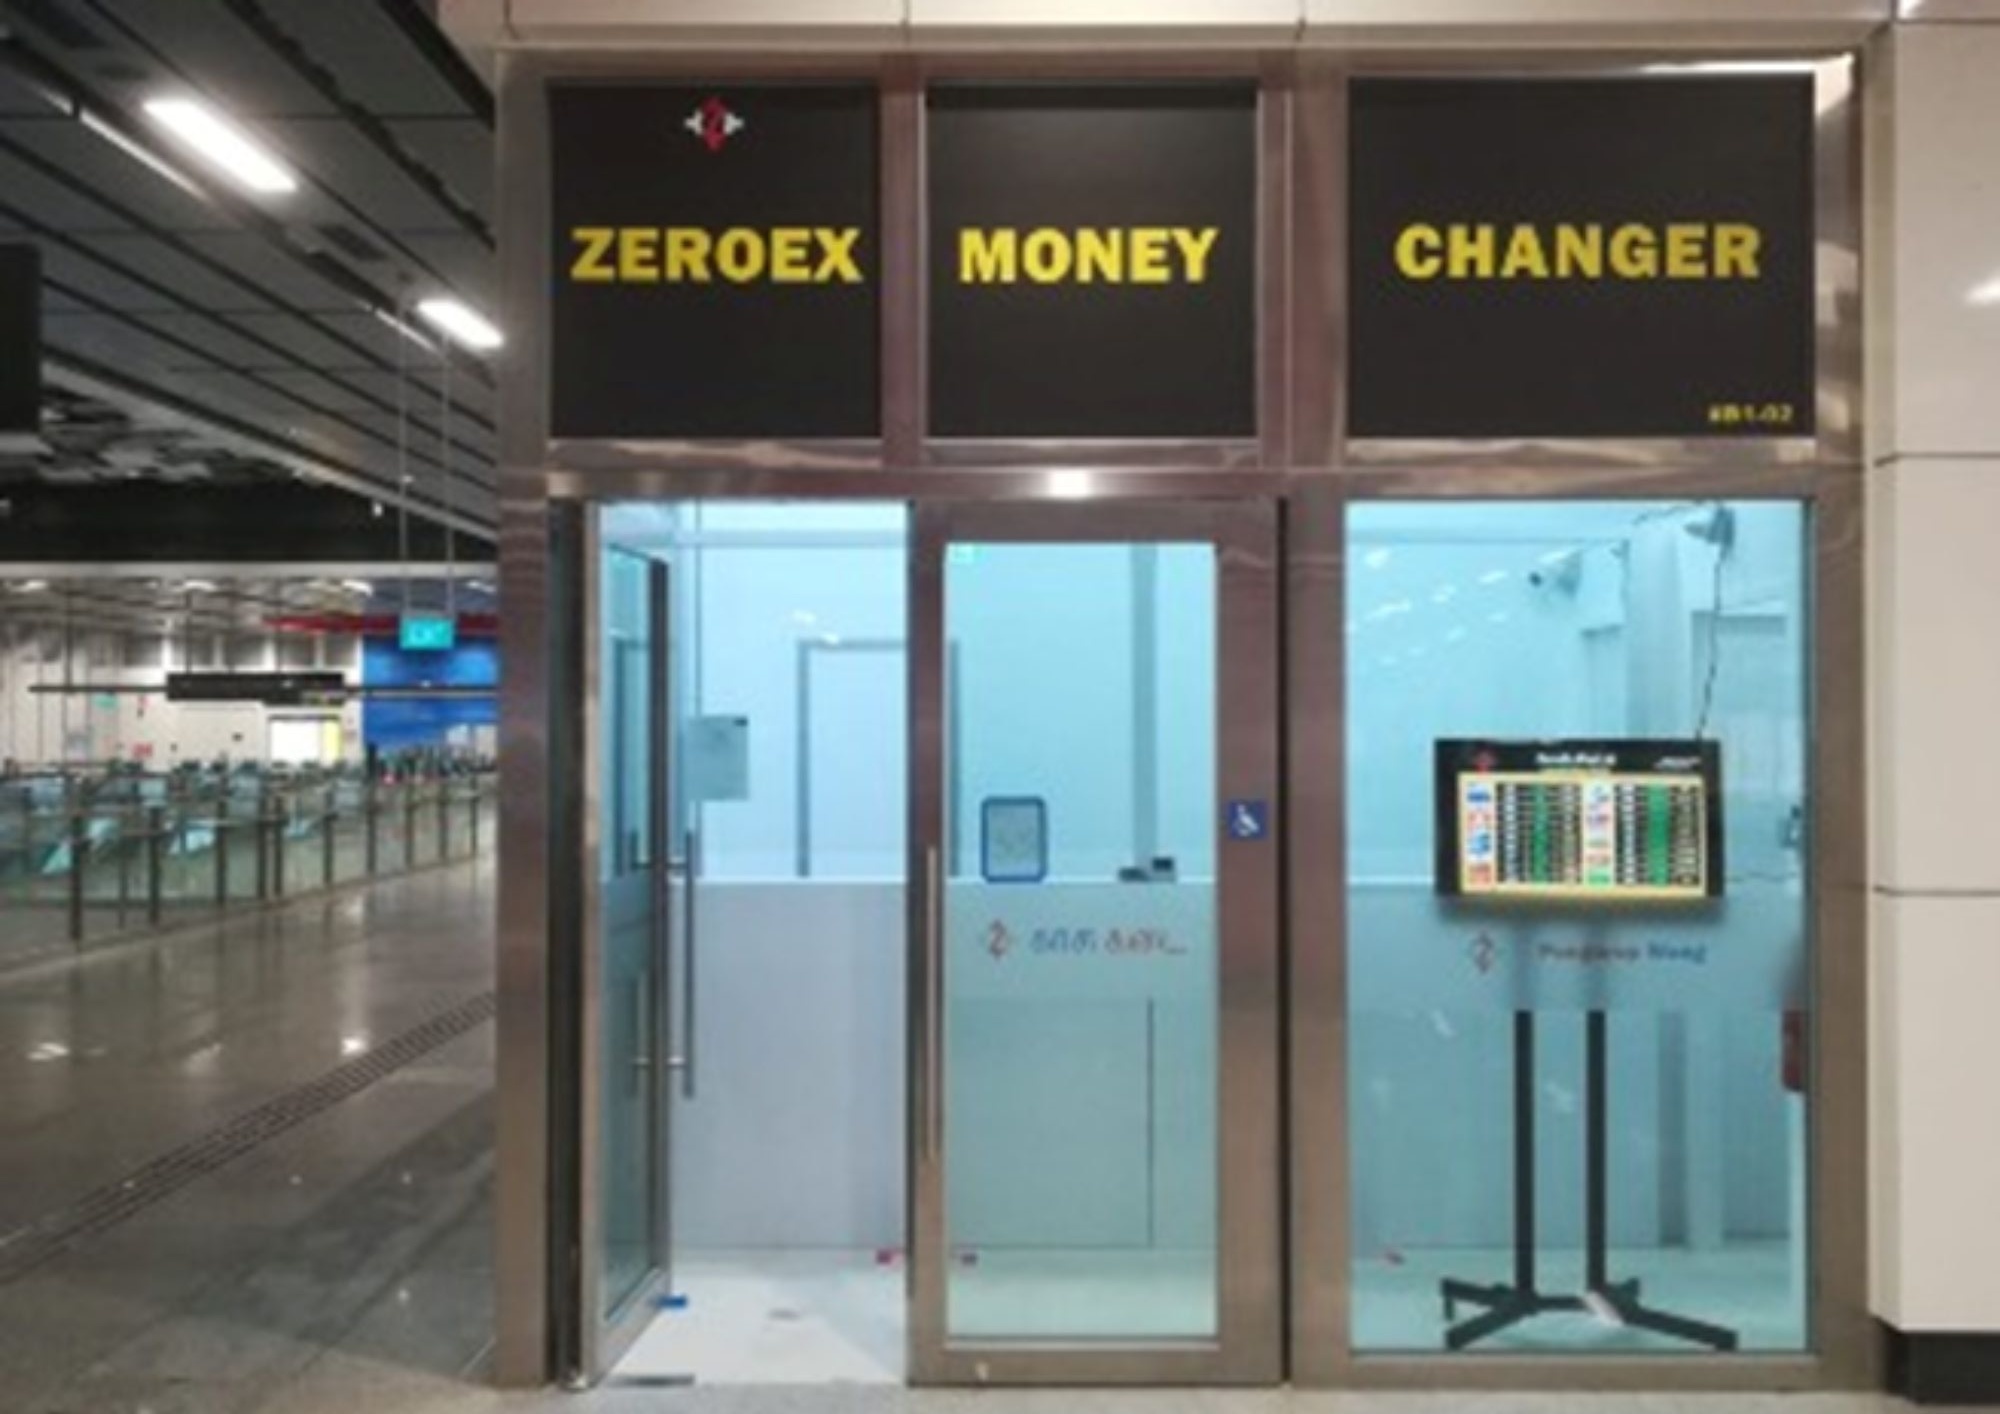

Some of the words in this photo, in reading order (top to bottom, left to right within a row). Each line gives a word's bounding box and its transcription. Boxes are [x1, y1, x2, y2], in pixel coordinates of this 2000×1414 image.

[570, 226, 864, 284] ZEROEX
[957, 225, 1219, 285] MONEY
[1394, 222, 1762, 280] CHANGER
